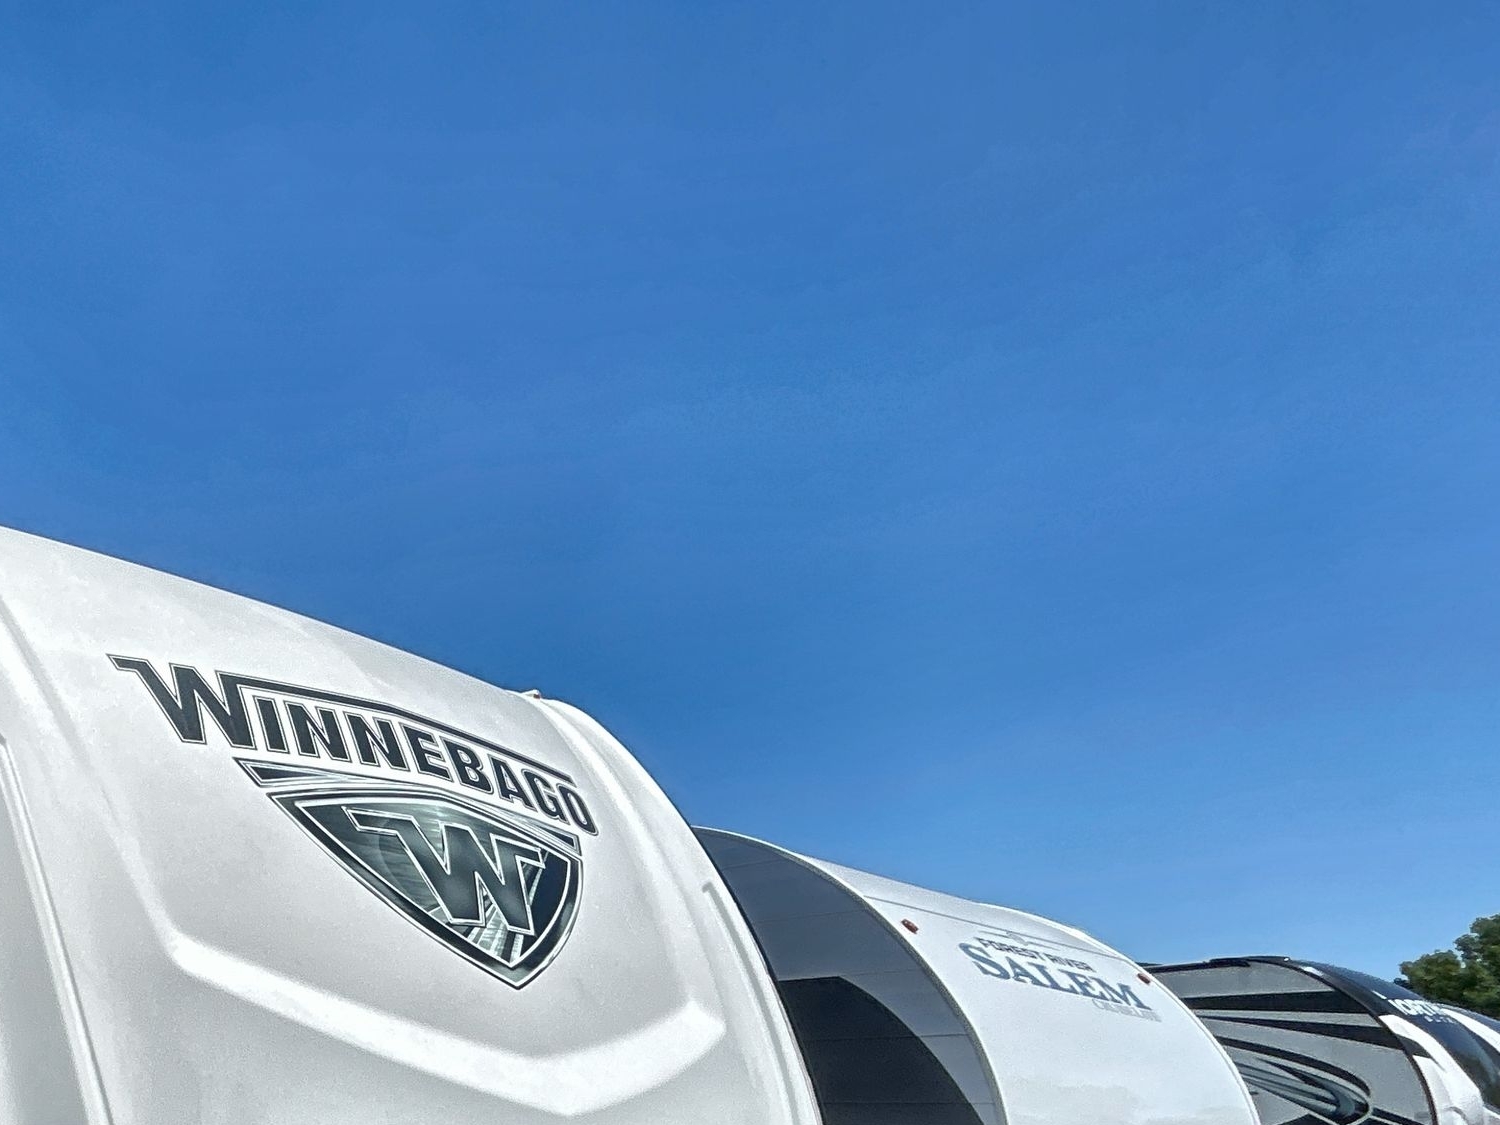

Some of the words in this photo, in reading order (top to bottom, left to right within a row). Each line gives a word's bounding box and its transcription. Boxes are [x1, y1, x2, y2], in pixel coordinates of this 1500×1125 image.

[106, 653, 598, 836] WINNEBAGO
[958, 942, 1153, 1011] SALEM
[973, 936, 1045, 963] FOREST
